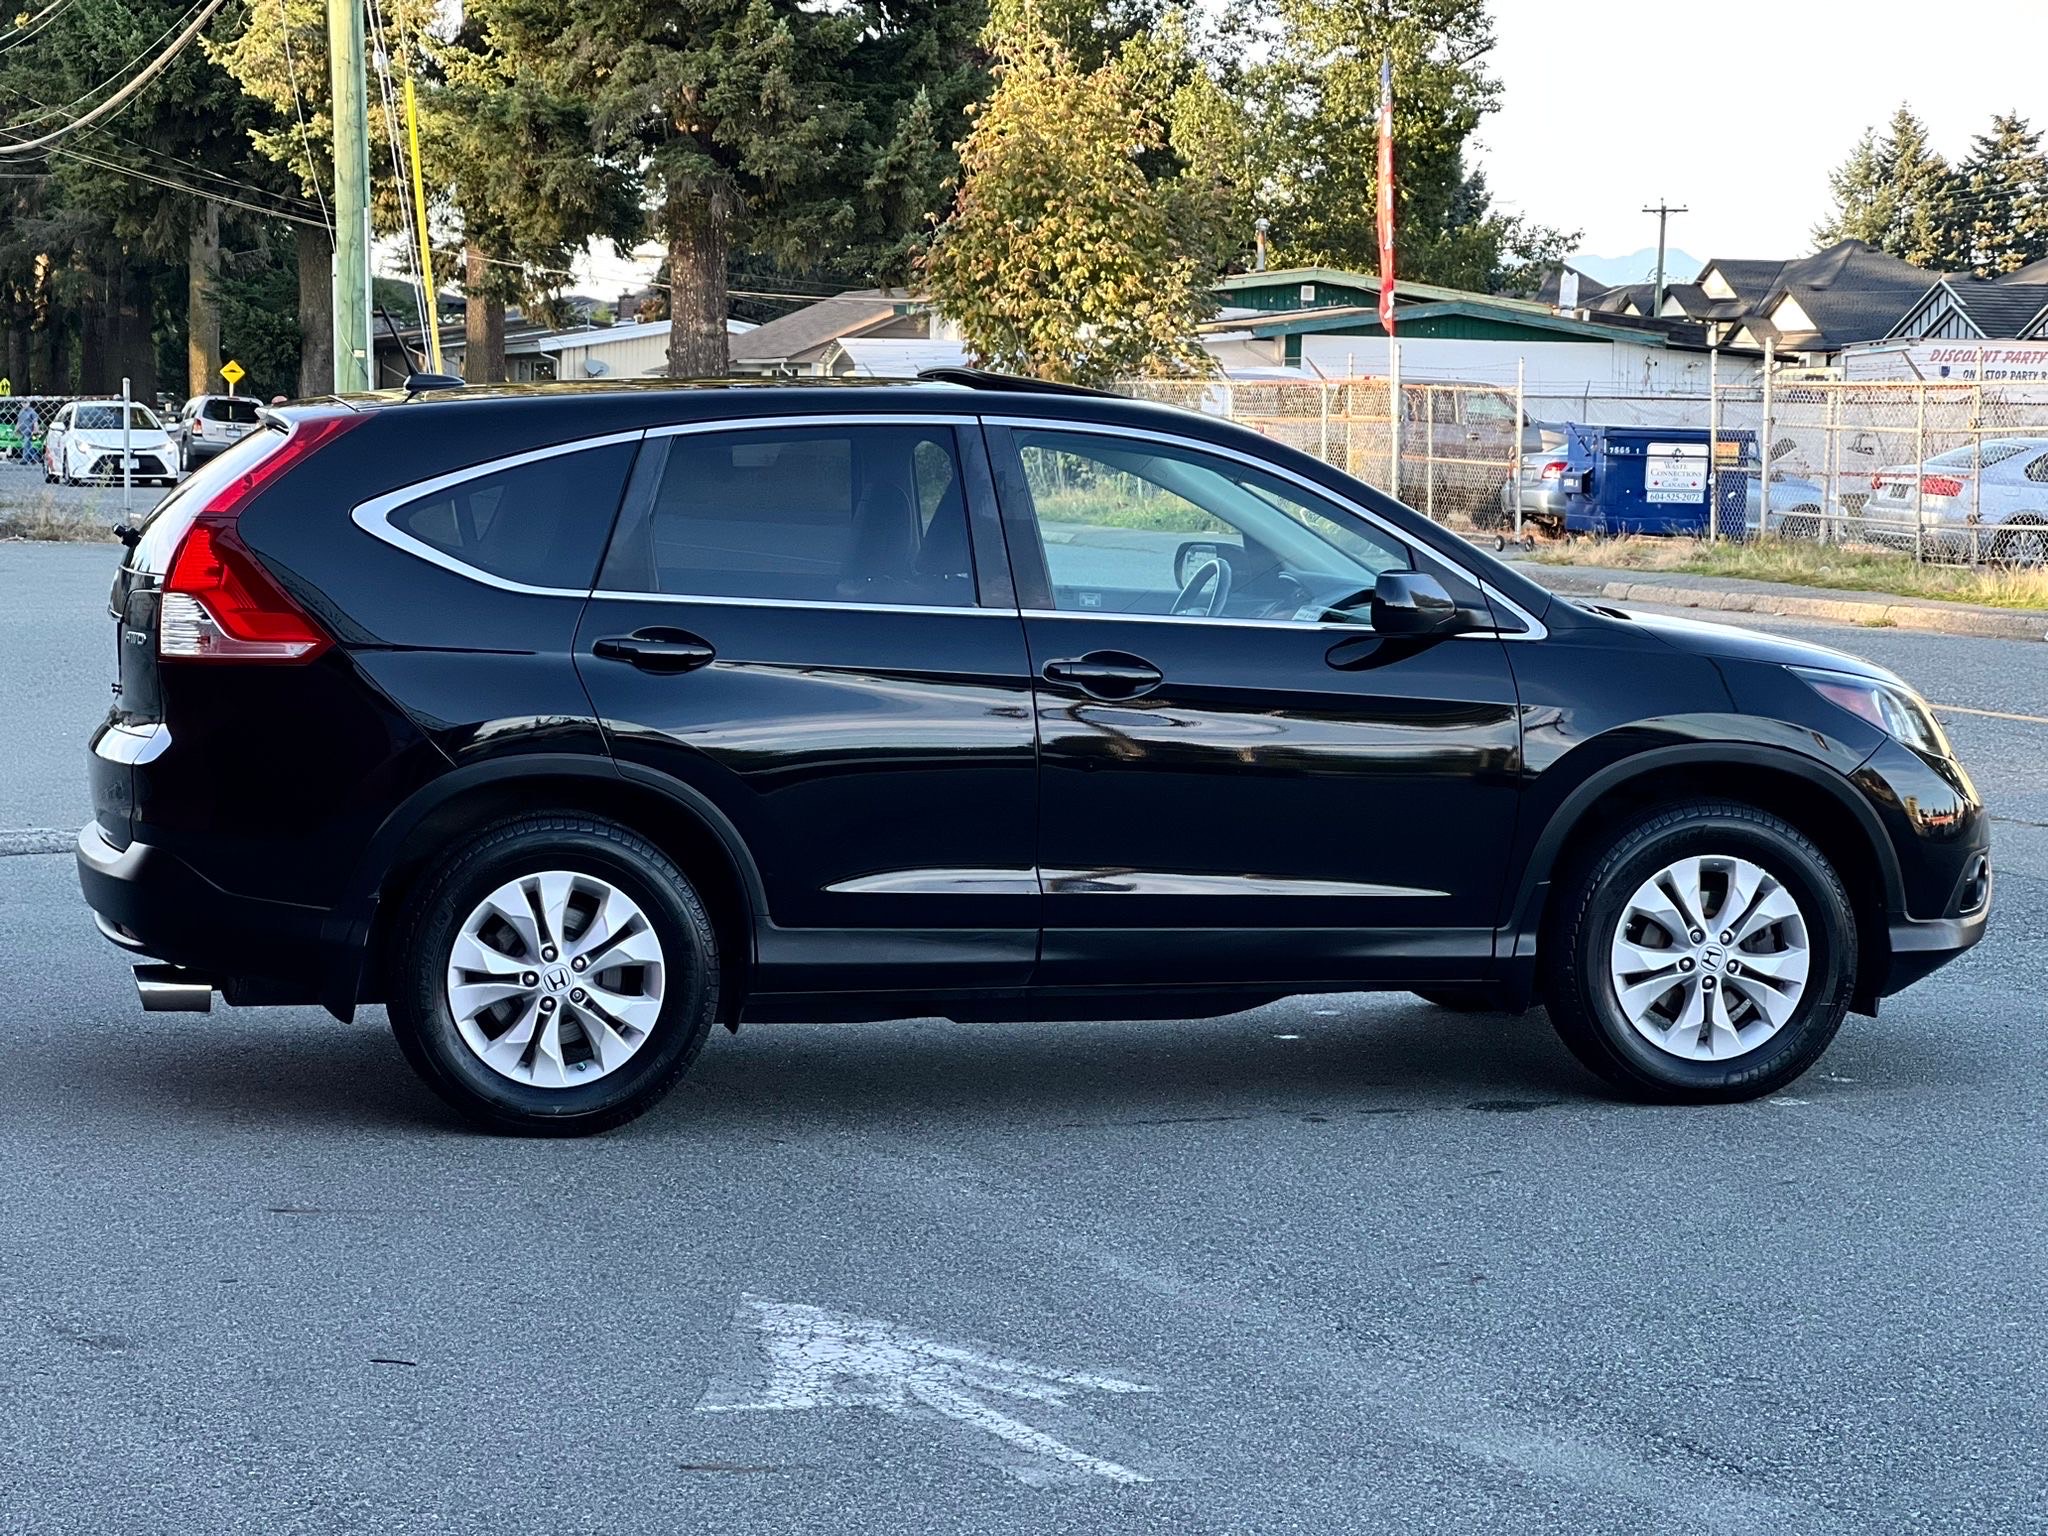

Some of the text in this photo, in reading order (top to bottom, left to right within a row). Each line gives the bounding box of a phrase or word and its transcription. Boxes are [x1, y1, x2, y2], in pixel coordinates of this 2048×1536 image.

[2002, 350, 2048, 364] PARTY
[1984, 369, 2007, 380] STOP
[2010, 370, 2038, 380] PARTY
[1650, 469, 1702, 477] CONNECTIONS
[1661, 480, 1690, 488] CANADA
[1650, 493, 1700, 501] 604-525-2072
